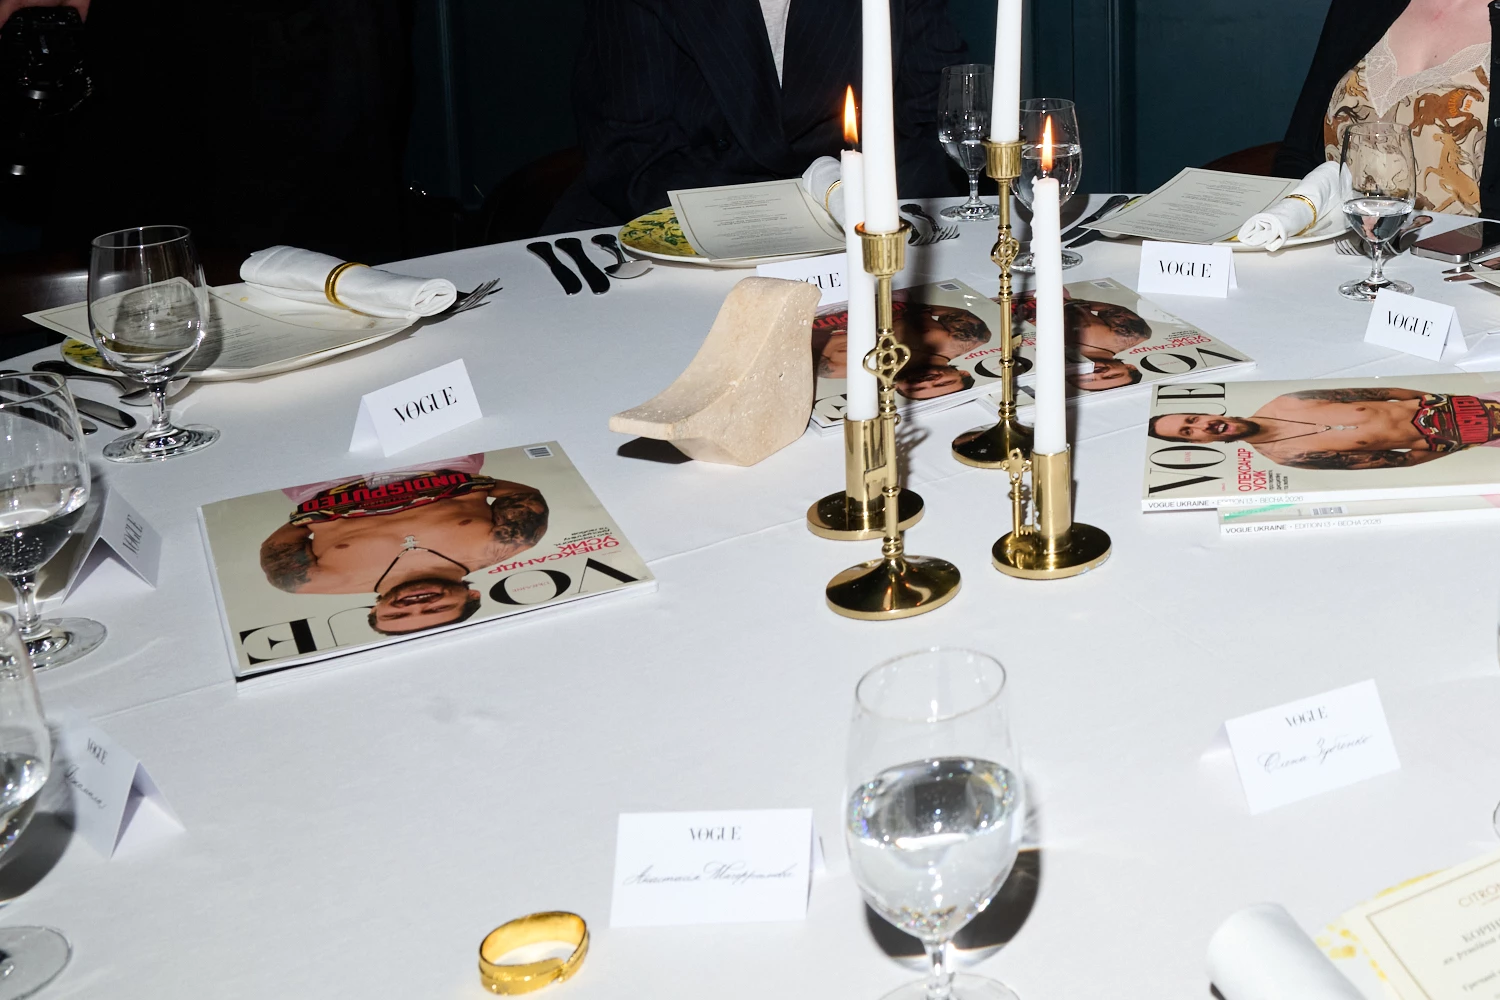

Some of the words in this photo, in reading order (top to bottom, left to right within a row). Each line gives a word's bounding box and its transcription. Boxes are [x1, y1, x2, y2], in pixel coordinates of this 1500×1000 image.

[795, 272, 841, 289] GUE
[1159, 260, 1211, 278] VOGUE
[1388, 310, 1433, 337] VOGUE
[392, 386, 457, 424] VOGUE
[1148, 383, 1227, 497] VOUE
[1238, 448, 1253, 492] ОЛЕКСАНДР
[1253, 470, 1267, 491] УСИК
[302, 474, 469, 514] UNDISPUTED
[1176, 500, 1209, 508] UKRAINE
[122, 514, 143, 556] VOGUE
[1294, 522, 1323, 530] EDITION
[488, 537, 620, 576] ОЛЕКСАНДР
[558, 534, 618, 552] УСИК
[239, 557, 640, 666] VOUE
[1285, 706, 1328, 727] VOGUE
[87, 738, 108, 765] VOGUE
[689, 826, 741, 841] VOGUE
